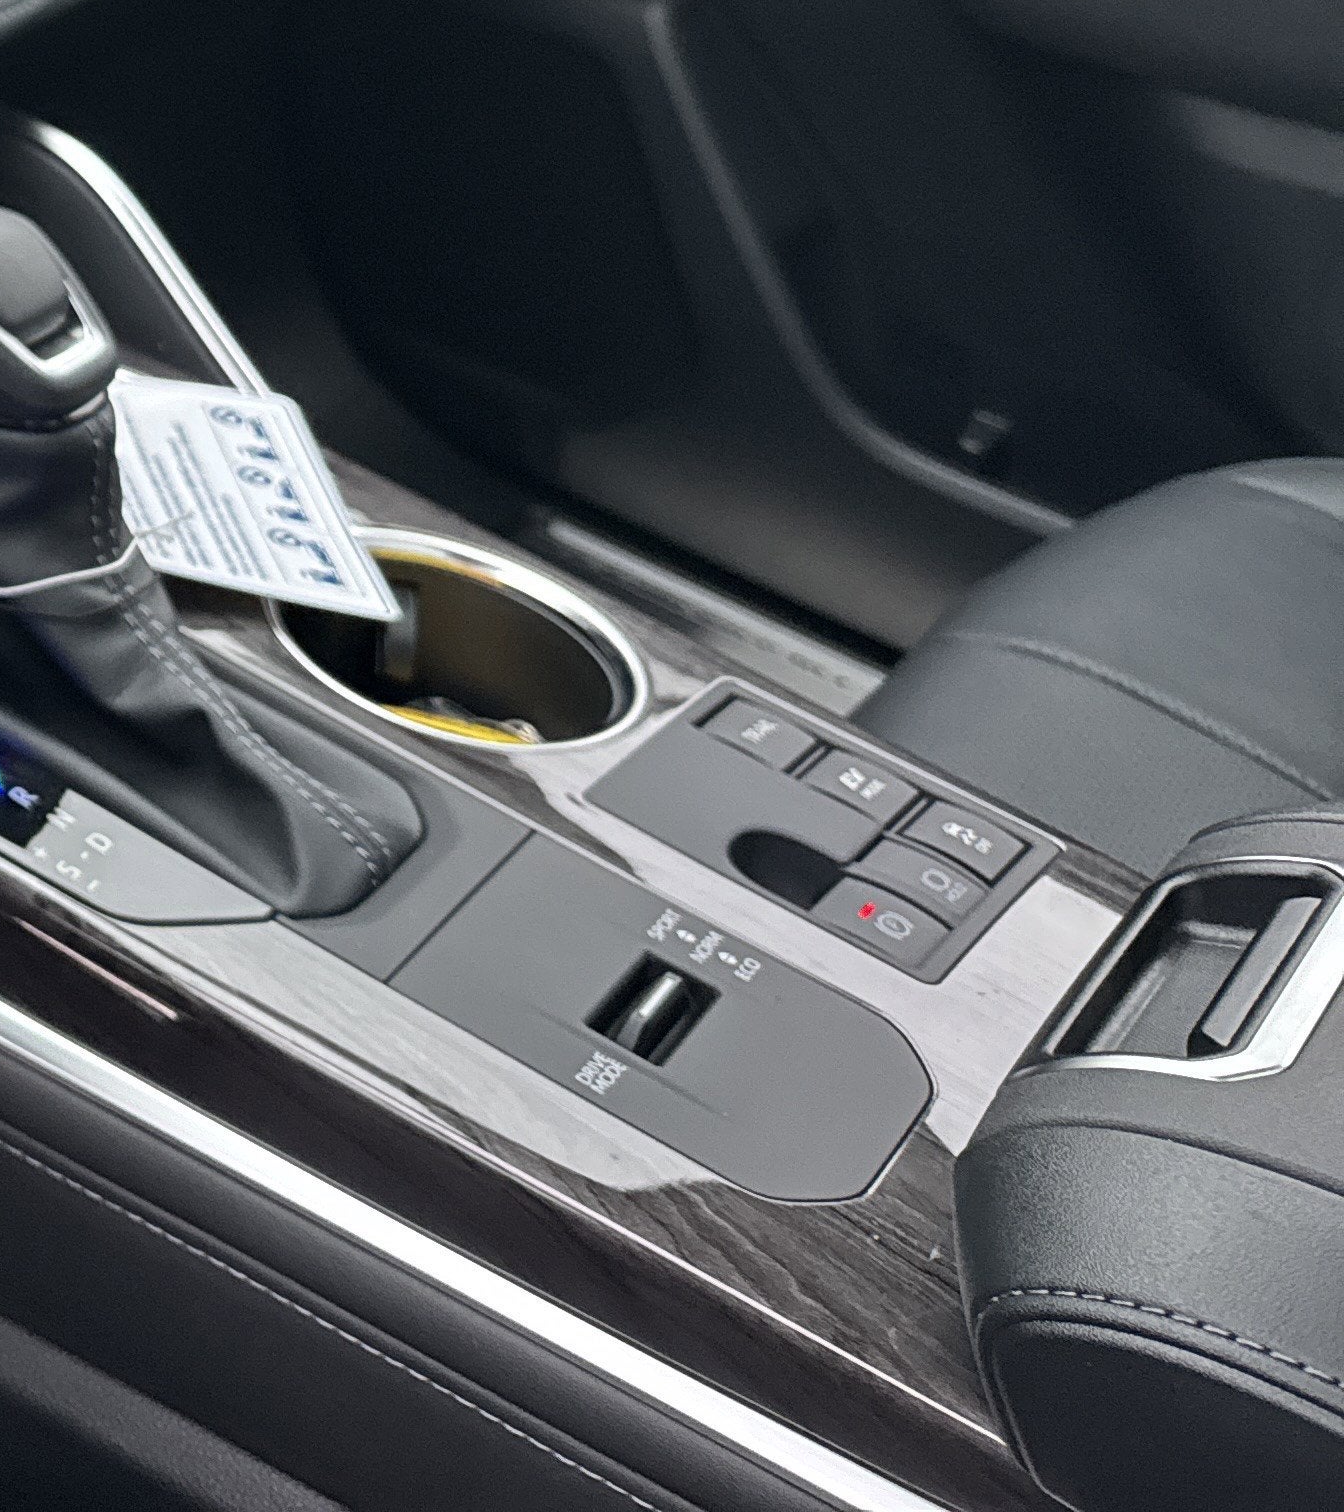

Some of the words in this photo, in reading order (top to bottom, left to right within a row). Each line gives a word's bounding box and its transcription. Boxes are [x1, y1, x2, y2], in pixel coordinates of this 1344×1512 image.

[7, 786, 40, 811] R
[46, 805, 76, 832] N
[85, 832, 113, 855] D
[55, 859, 82, 881] S
